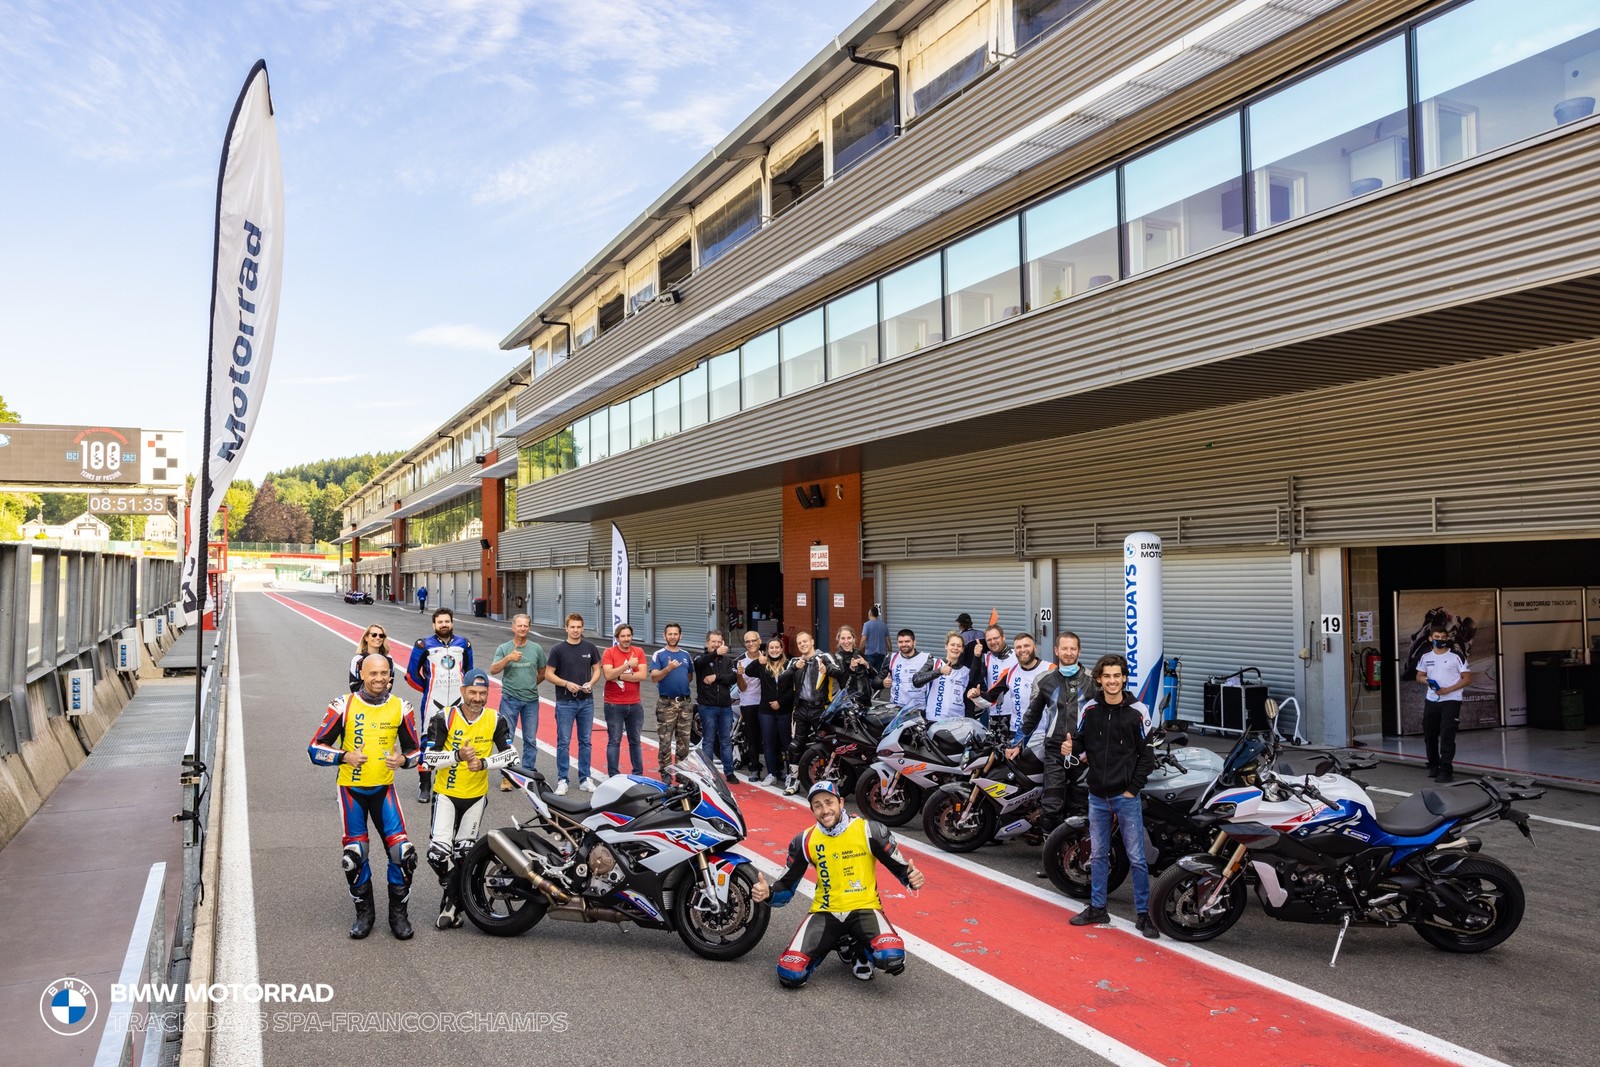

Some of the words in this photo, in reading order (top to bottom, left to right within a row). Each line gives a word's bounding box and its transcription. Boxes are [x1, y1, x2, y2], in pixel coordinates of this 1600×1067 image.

[217, 219, 262, 463] Motorrad
[80, 441, 120, 470] 100
[90, 497, 163, 511] 08:51:35
[1041, 609, 1051, 620] 20
[1125, 563, 1139, 690] TRACKDAYS
[1323, 617, 1340, 632] 19
[893, 663, 902, 705] TRACKDAYS
[934, 674, 947, 718] TRACKDAY
